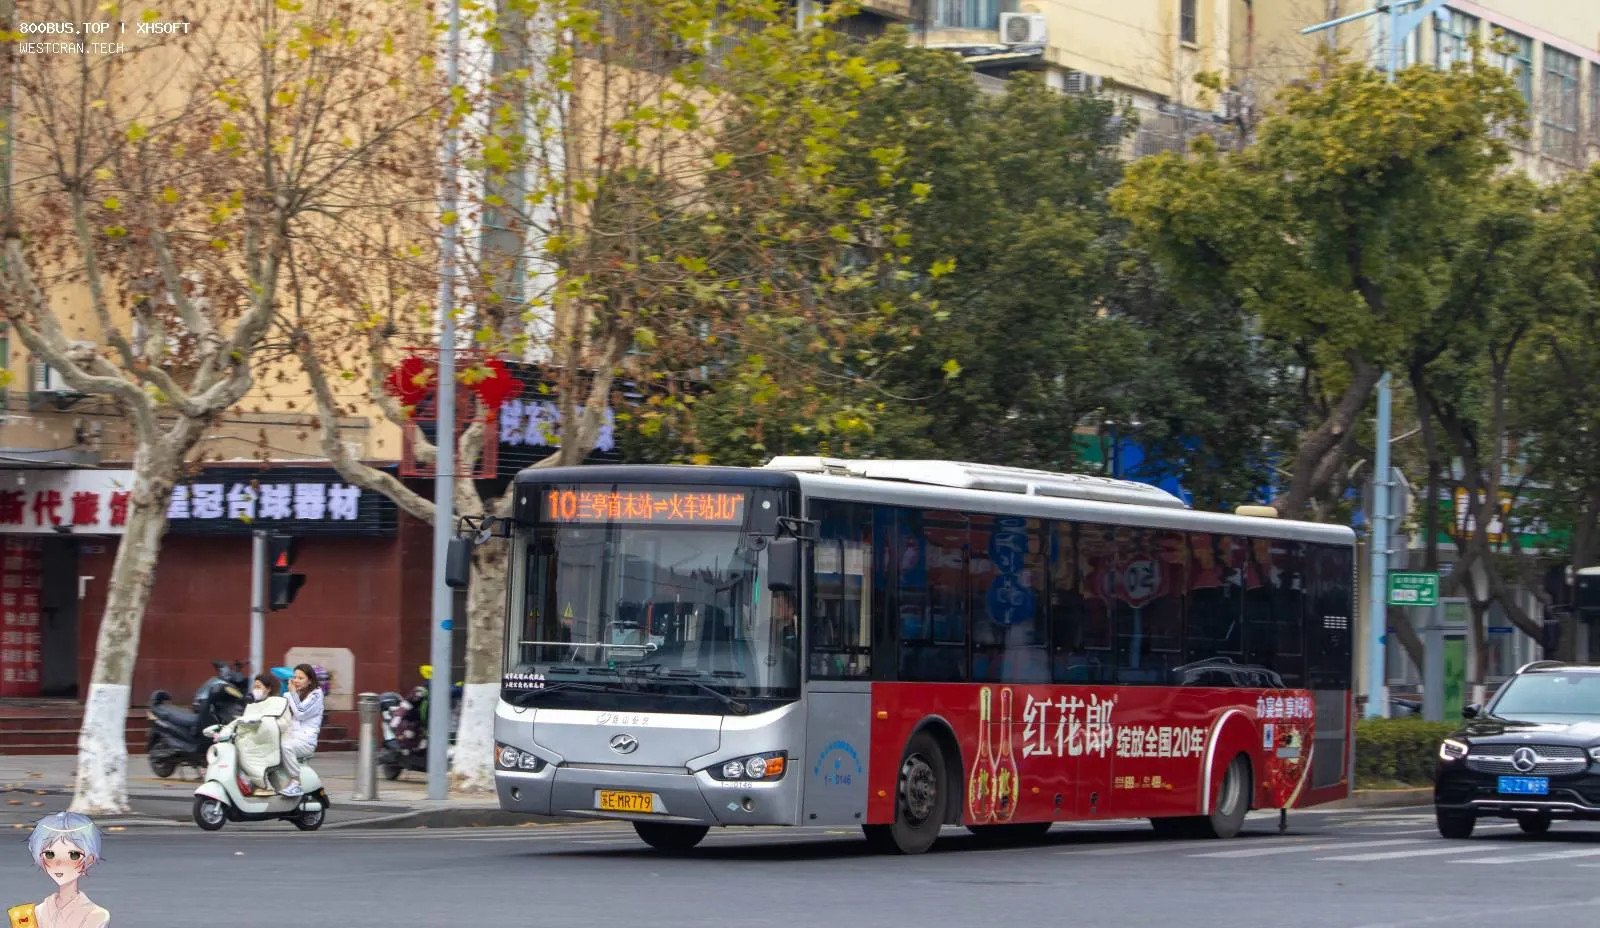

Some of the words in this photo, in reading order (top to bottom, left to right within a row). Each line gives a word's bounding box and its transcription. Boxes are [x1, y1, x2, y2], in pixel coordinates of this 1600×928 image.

[166, 483, 361, 520] 皇冠台球器材
[549, 491, 577, 520] 10
[1022, 693, 1114, 759] 红花郎
[1116, 725, 1204, 758] 绽放全国20年
